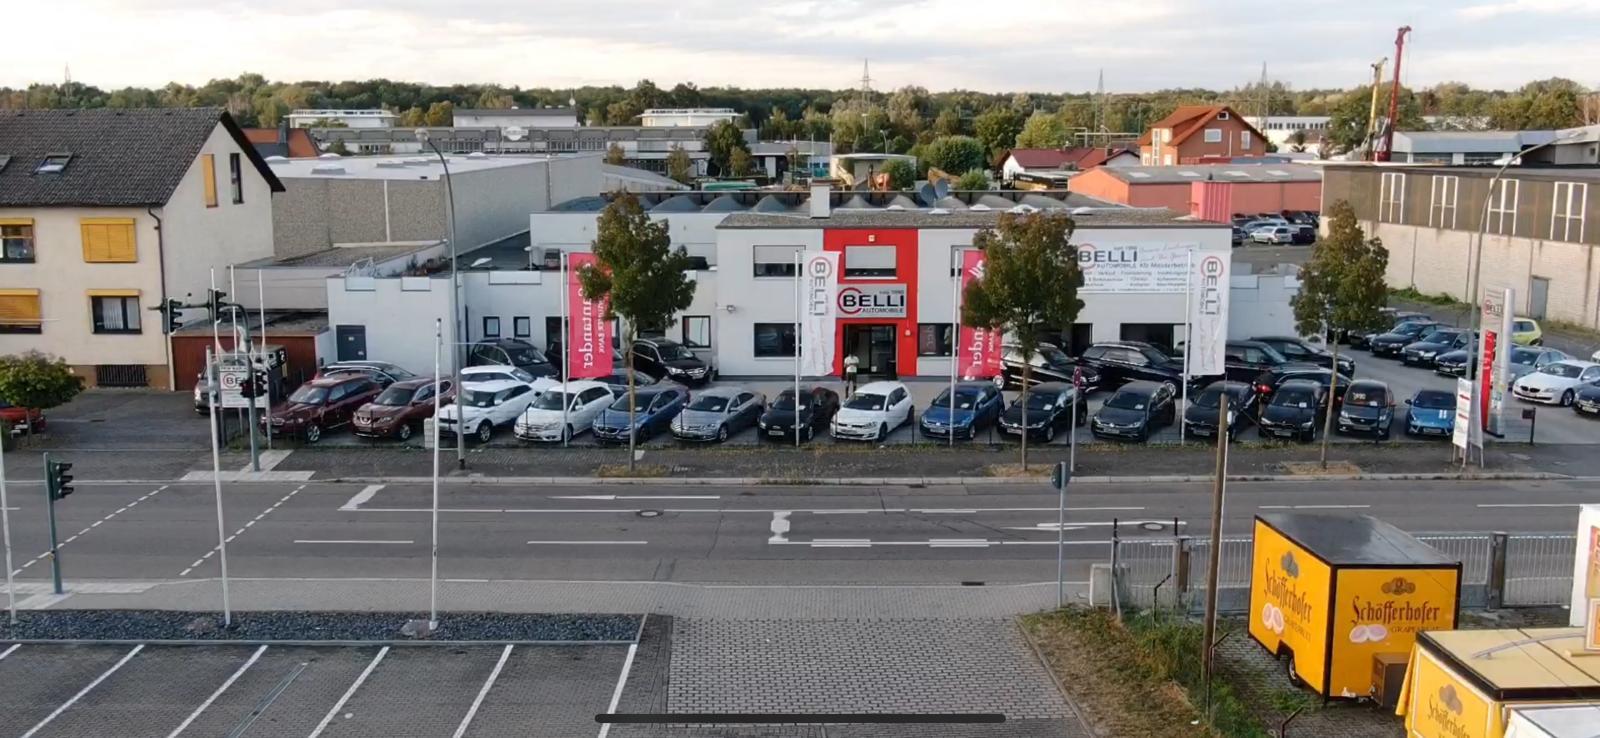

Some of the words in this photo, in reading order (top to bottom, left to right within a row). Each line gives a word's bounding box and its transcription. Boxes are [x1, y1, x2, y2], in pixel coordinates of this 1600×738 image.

[1079, 251, 1137, 262] BELLI
[814, 262, 825, 315] BELLI
[843, 294, 905, 307] BELLI
[1206, 261, 1217, 314] BELLI
[1263, 557, 1313, 624] Schöfferhofer
[1351, 595, 1441, 626] Schöfferhofer
